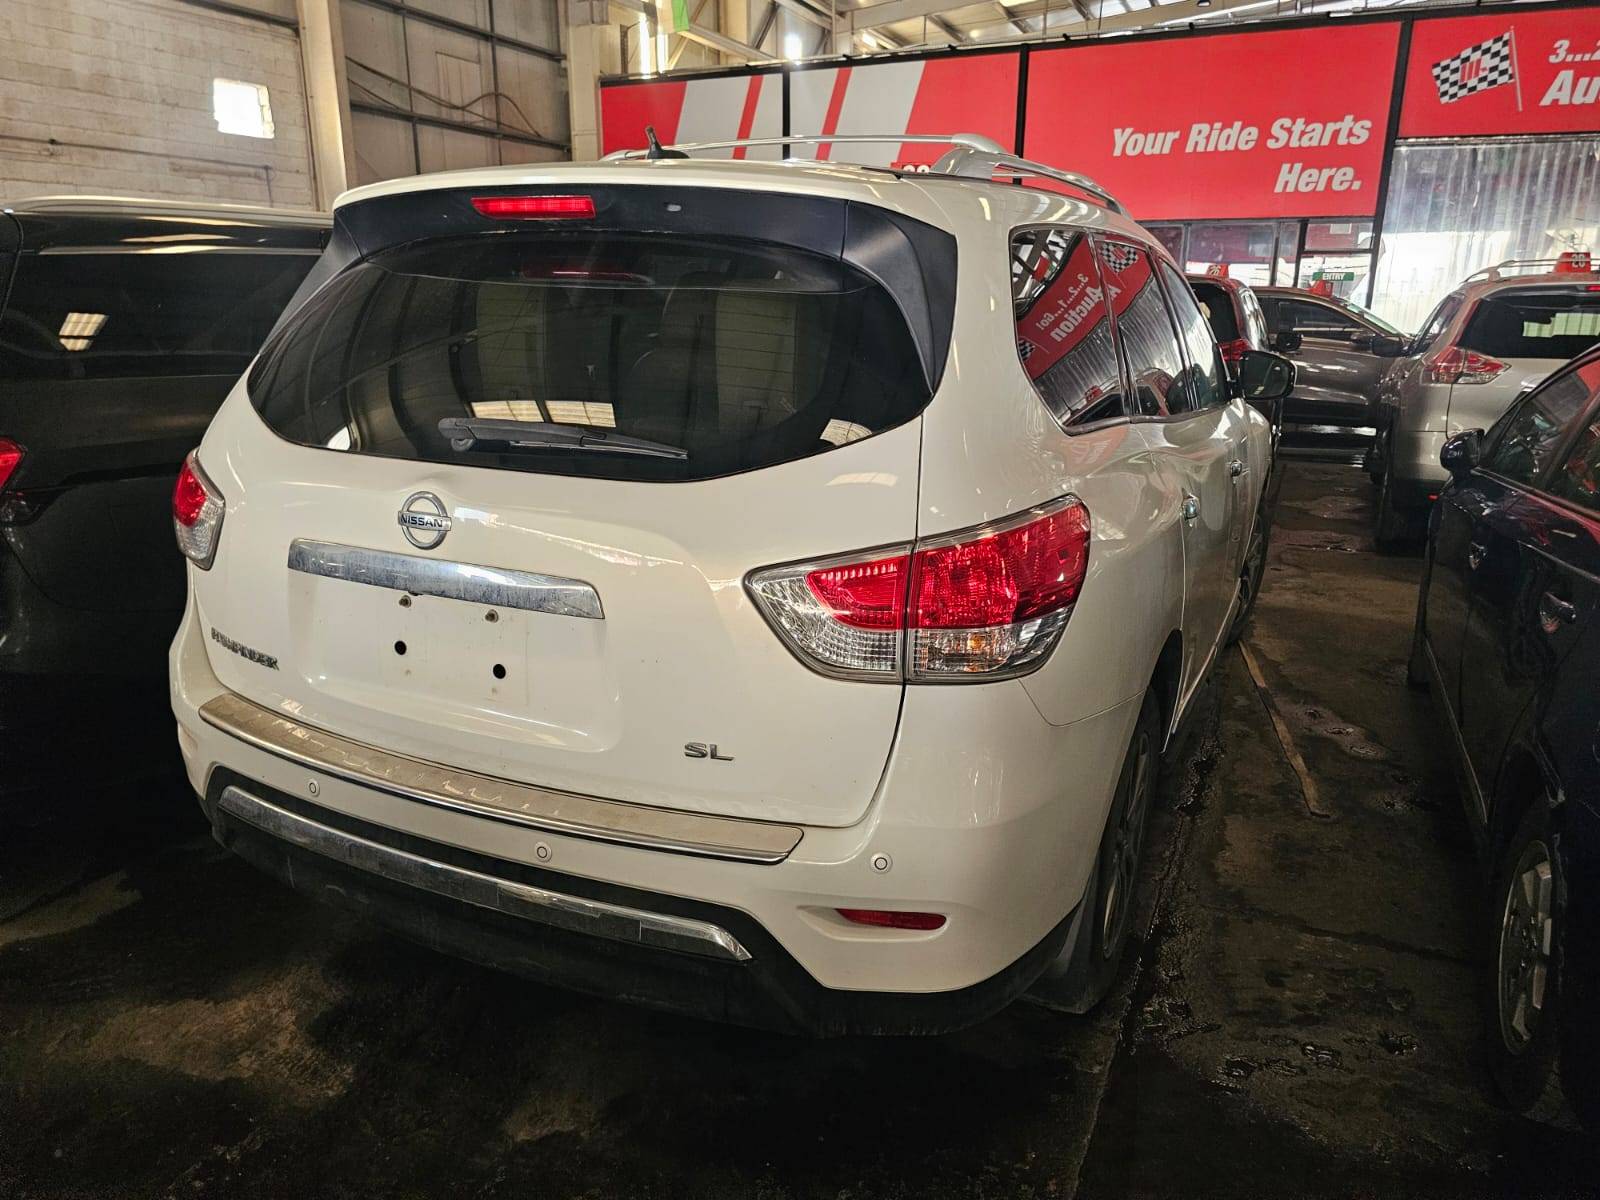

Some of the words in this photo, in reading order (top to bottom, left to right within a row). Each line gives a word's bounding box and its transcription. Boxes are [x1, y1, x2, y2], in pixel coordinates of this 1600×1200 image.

[1539, 69, 1600, 106] Au
[1113, 128, 1180, 157] Your
[1185, 121, 1258, 153] Ride
[1266, 114, 1372, 149] Starts
[1274, 162, 1362, 193] Here.
[1322, 272, 1346, 281] ENTRY
[400, 514, 443, 528] NISSAN
[684, 741, 735, 761] SL
